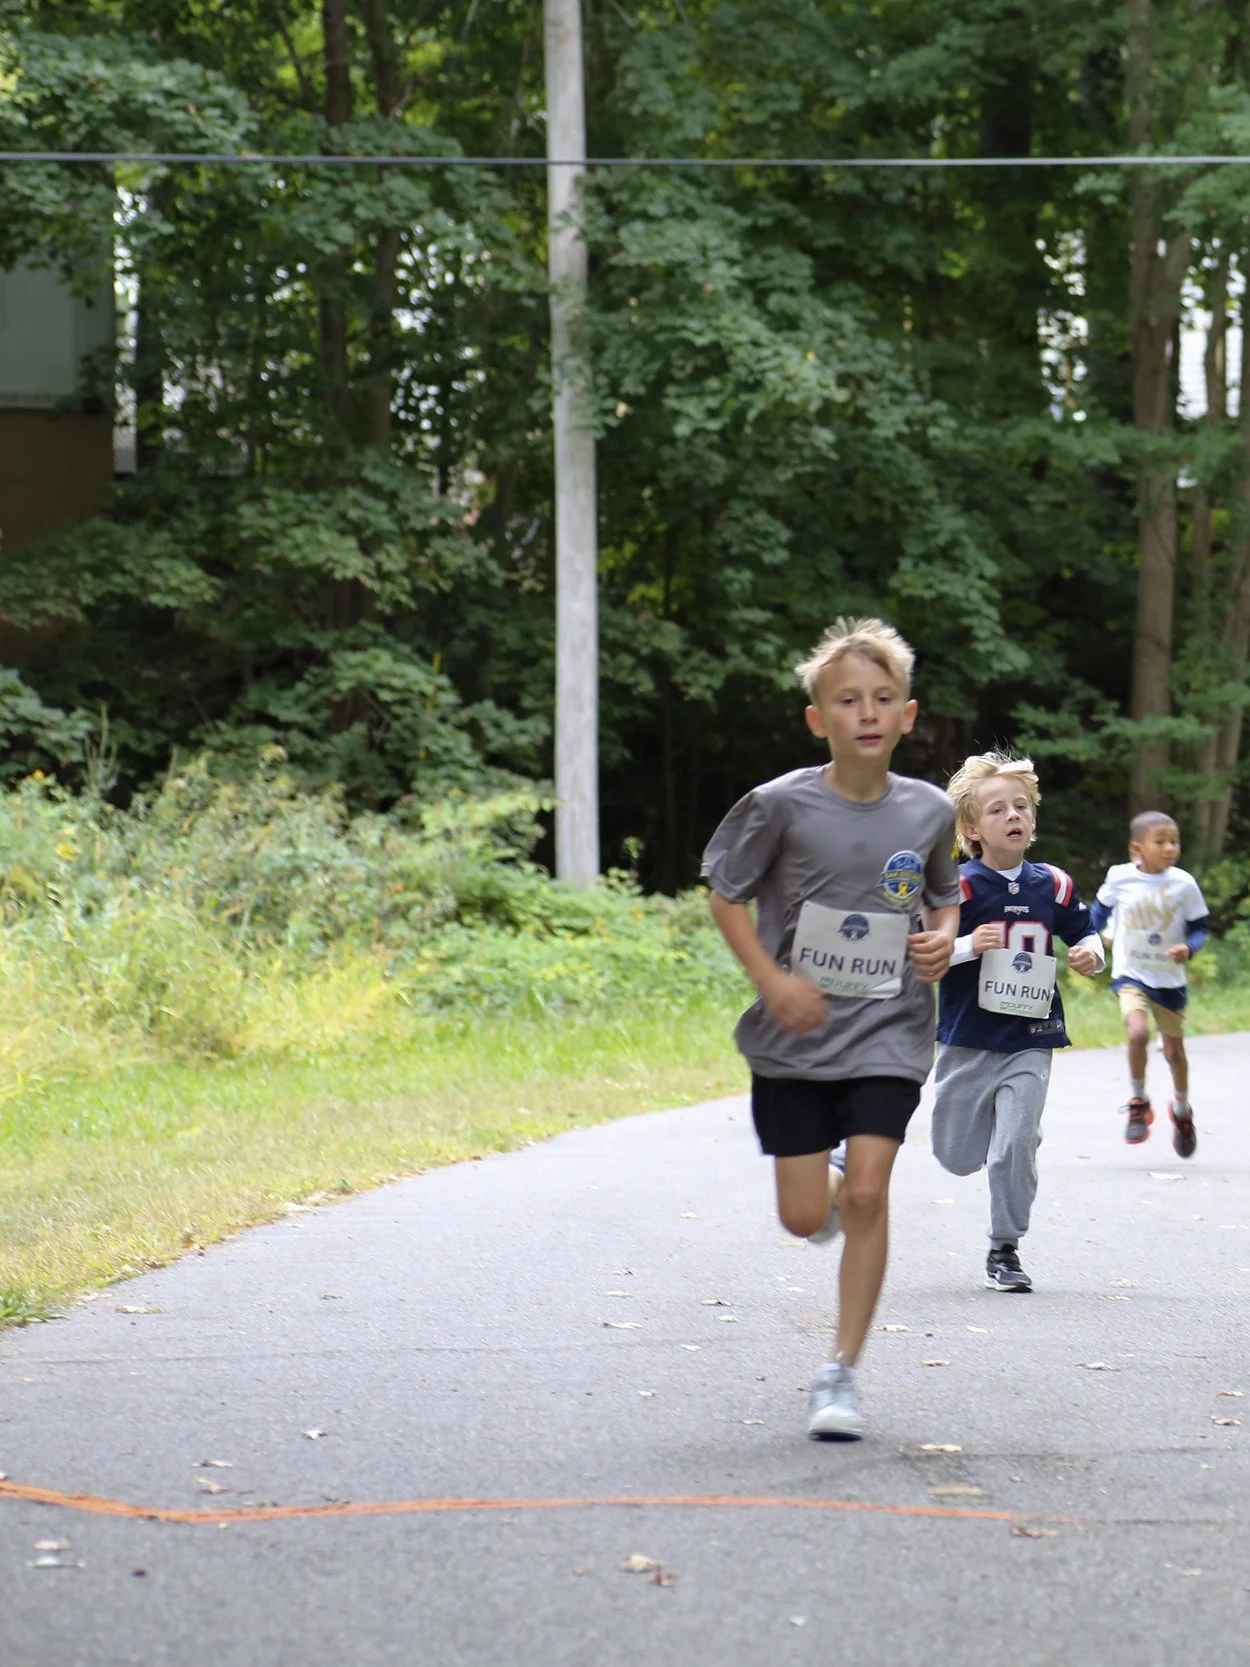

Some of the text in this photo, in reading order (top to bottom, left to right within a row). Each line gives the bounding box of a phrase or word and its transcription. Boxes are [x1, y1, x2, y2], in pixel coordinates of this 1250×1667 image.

[799, 946, 897, 976] FUN RUN
[984, 980, 1052, 1002] FUN RUN
